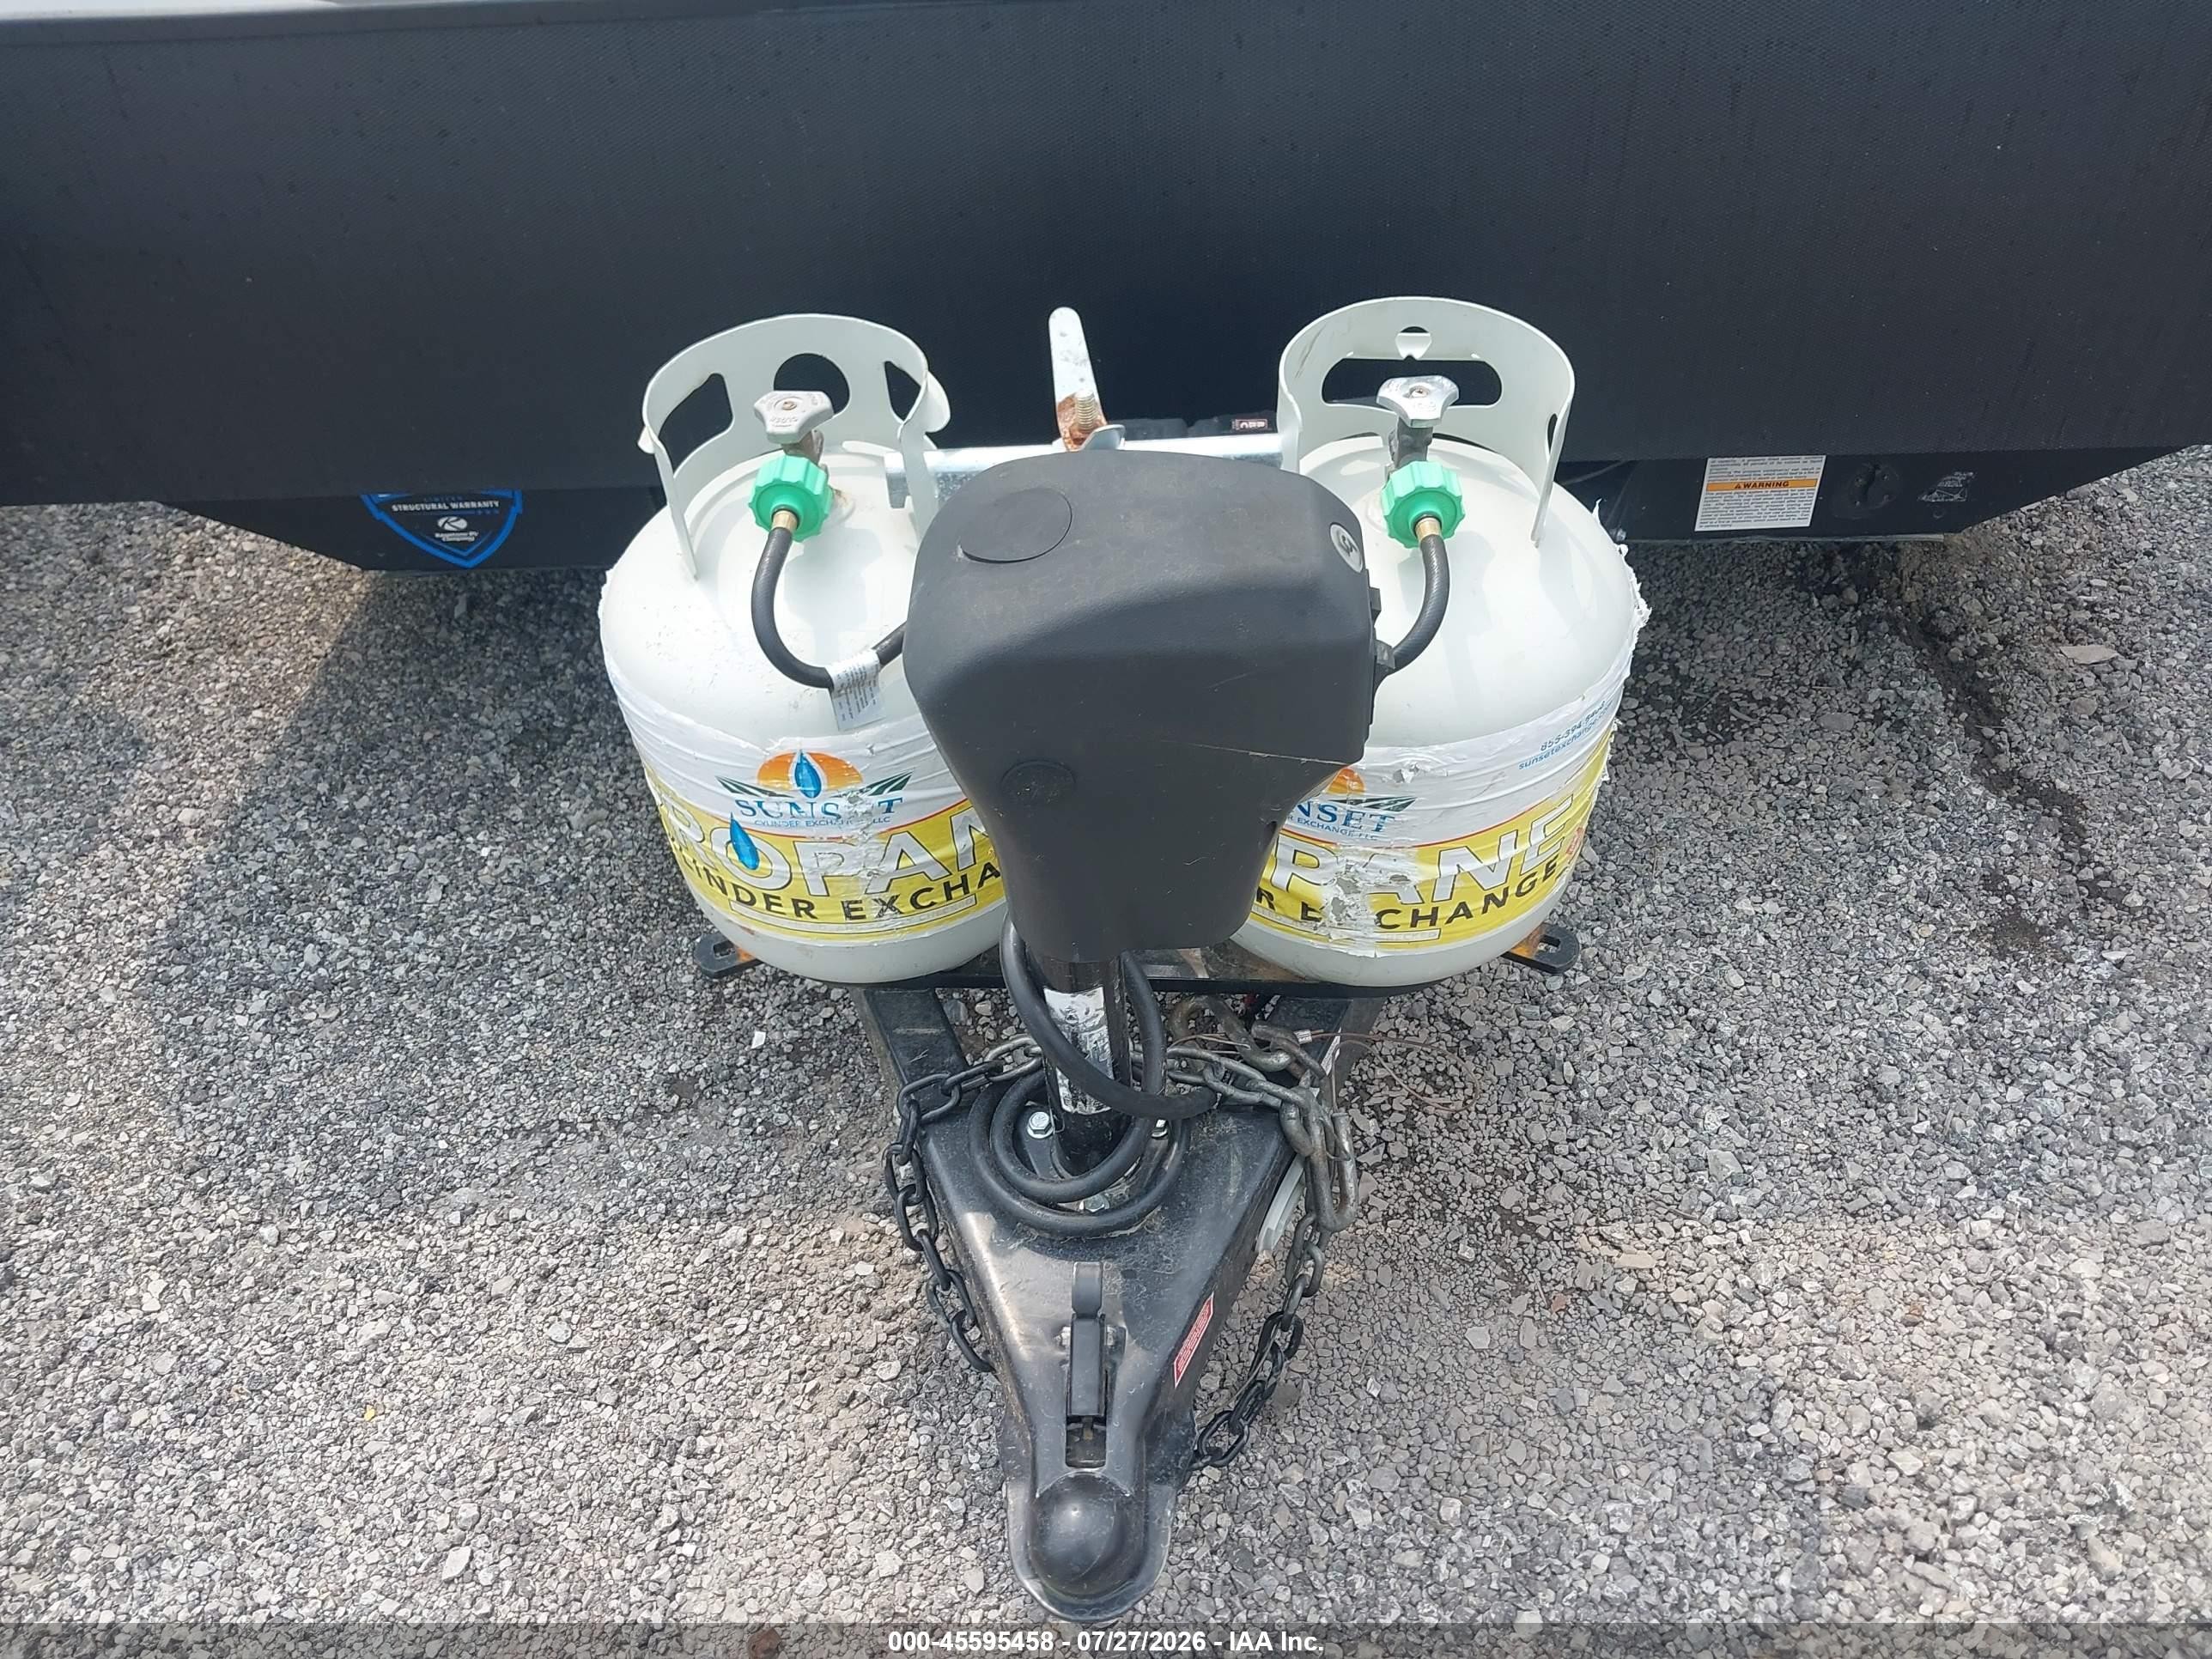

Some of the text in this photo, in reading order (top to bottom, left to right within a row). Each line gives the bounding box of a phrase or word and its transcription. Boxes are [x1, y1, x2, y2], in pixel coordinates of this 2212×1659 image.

[1742, 480, 1790, 489] WARNING
[392, 500, 500, 513] STRUCTURAL WARRANTY
[734, 797, 903, 820] SUNST
[1296, 799, 1395, 833] NSET
[1271, 793, 1574, 906] PANE
[841, 861, 1001, 921] EXCHA
[1300, 862, 1557, 929] ECHANGE
